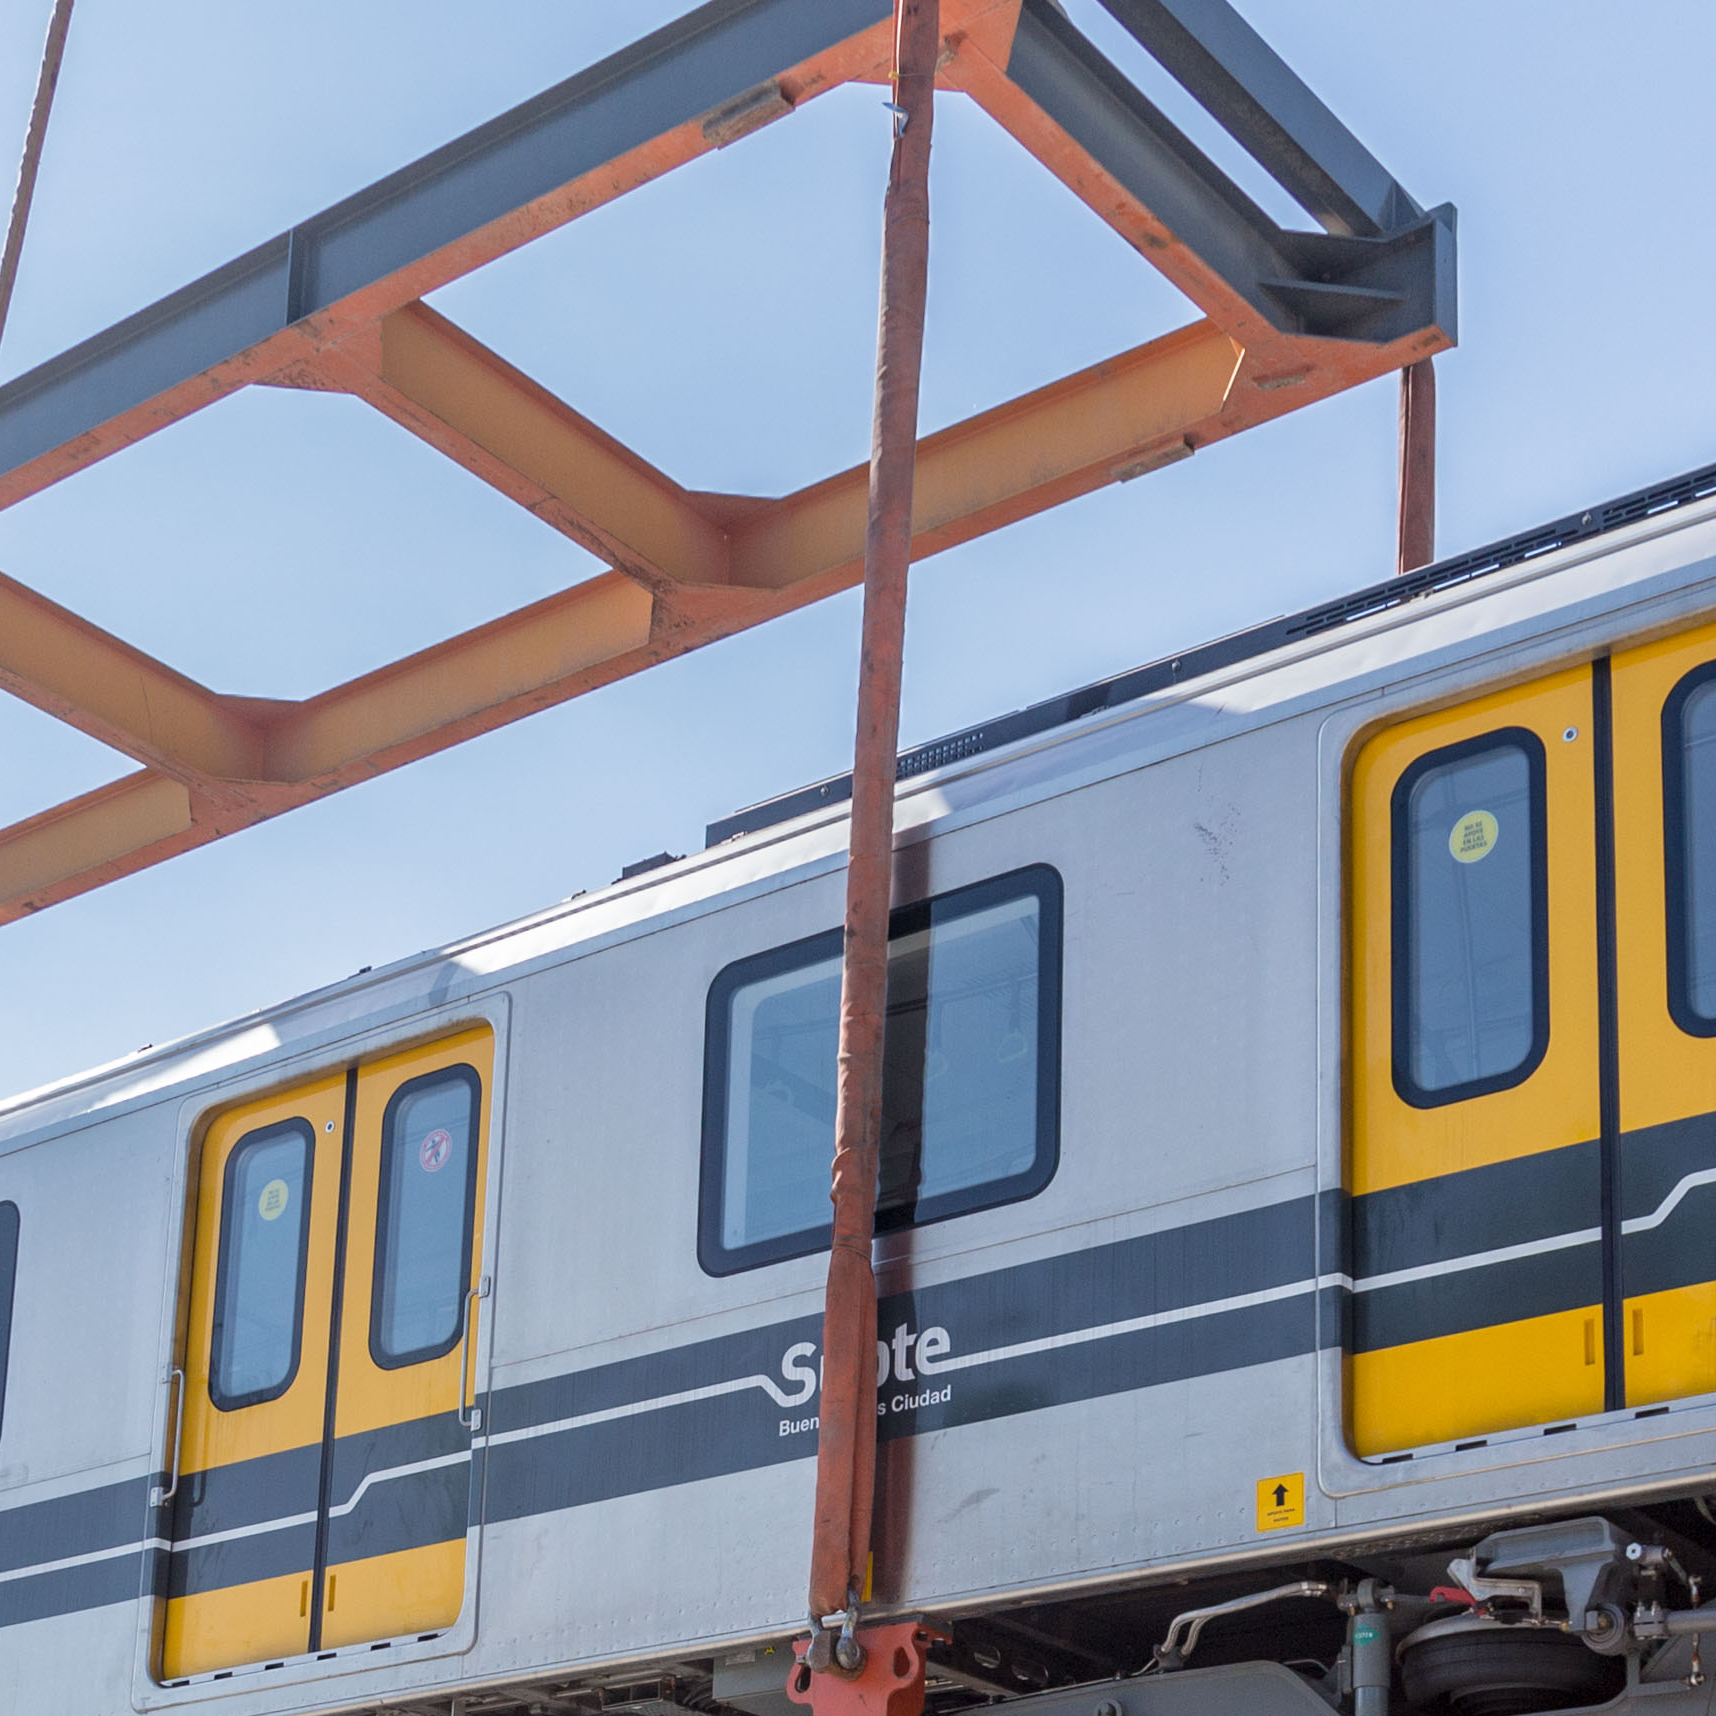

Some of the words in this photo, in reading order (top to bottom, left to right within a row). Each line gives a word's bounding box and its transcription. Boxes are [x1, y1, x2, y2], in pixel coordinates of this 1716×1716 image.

[782, 1322, 952, 1407] Ste
[779, 1415, 820, 1437] Buen
[891, 1385, 952, 1413] Ciudad
